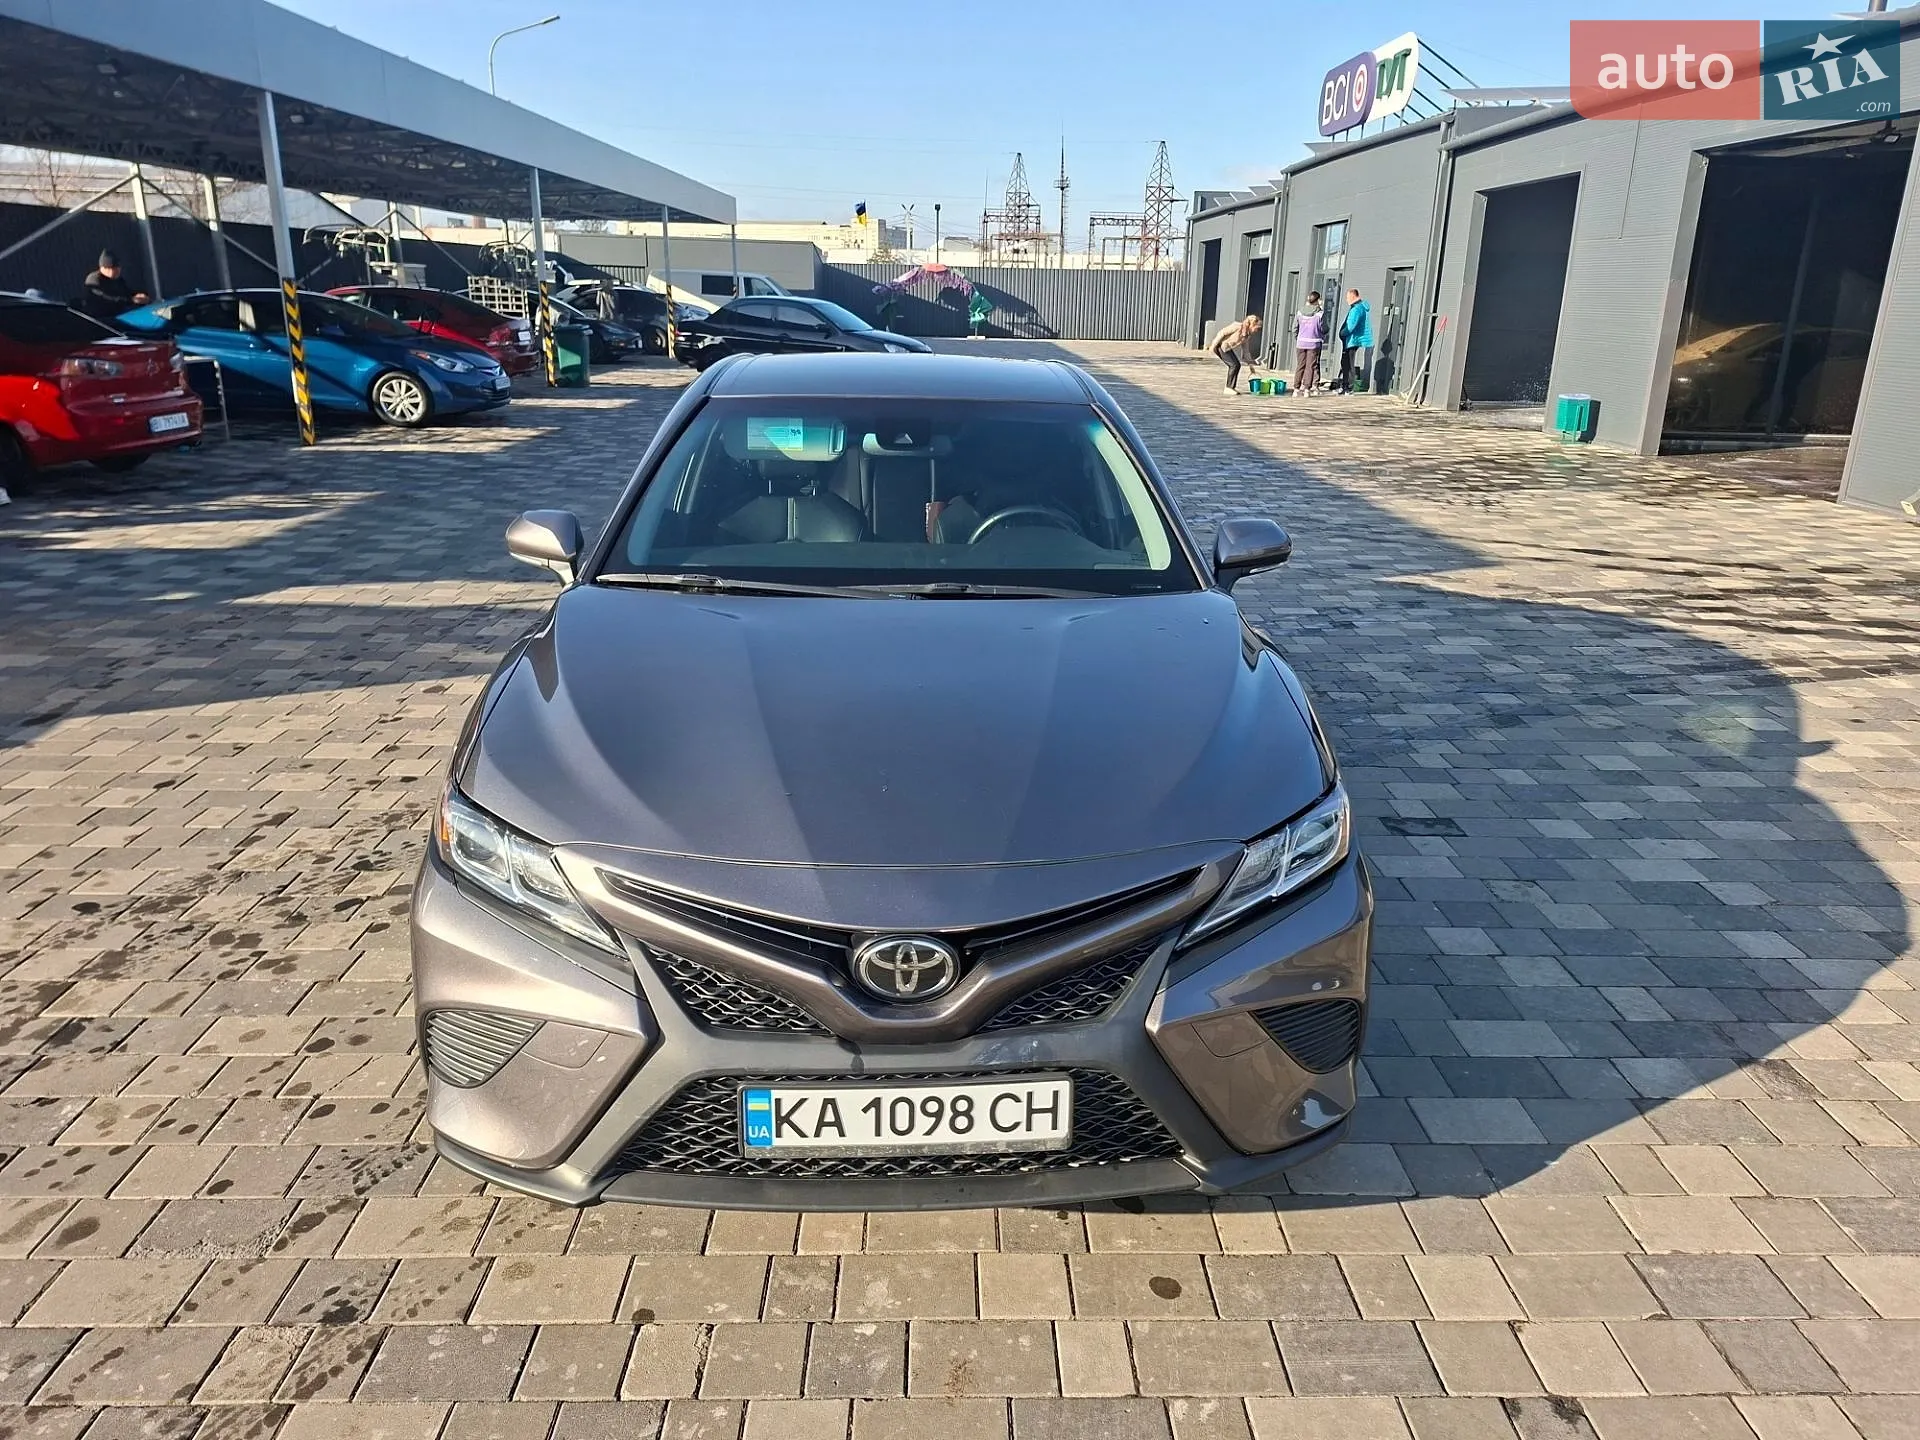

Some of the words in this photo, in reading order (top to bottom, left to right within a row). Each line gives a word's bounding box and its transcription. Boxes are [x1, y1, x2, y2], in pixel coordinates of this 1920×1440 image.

[775, 1096, 846, 1138] KA
[861, 1094, 975, 1137] 1098
[989, 1090, 1059, 1133] CH
[748, 1125, 770, 1139] UA
